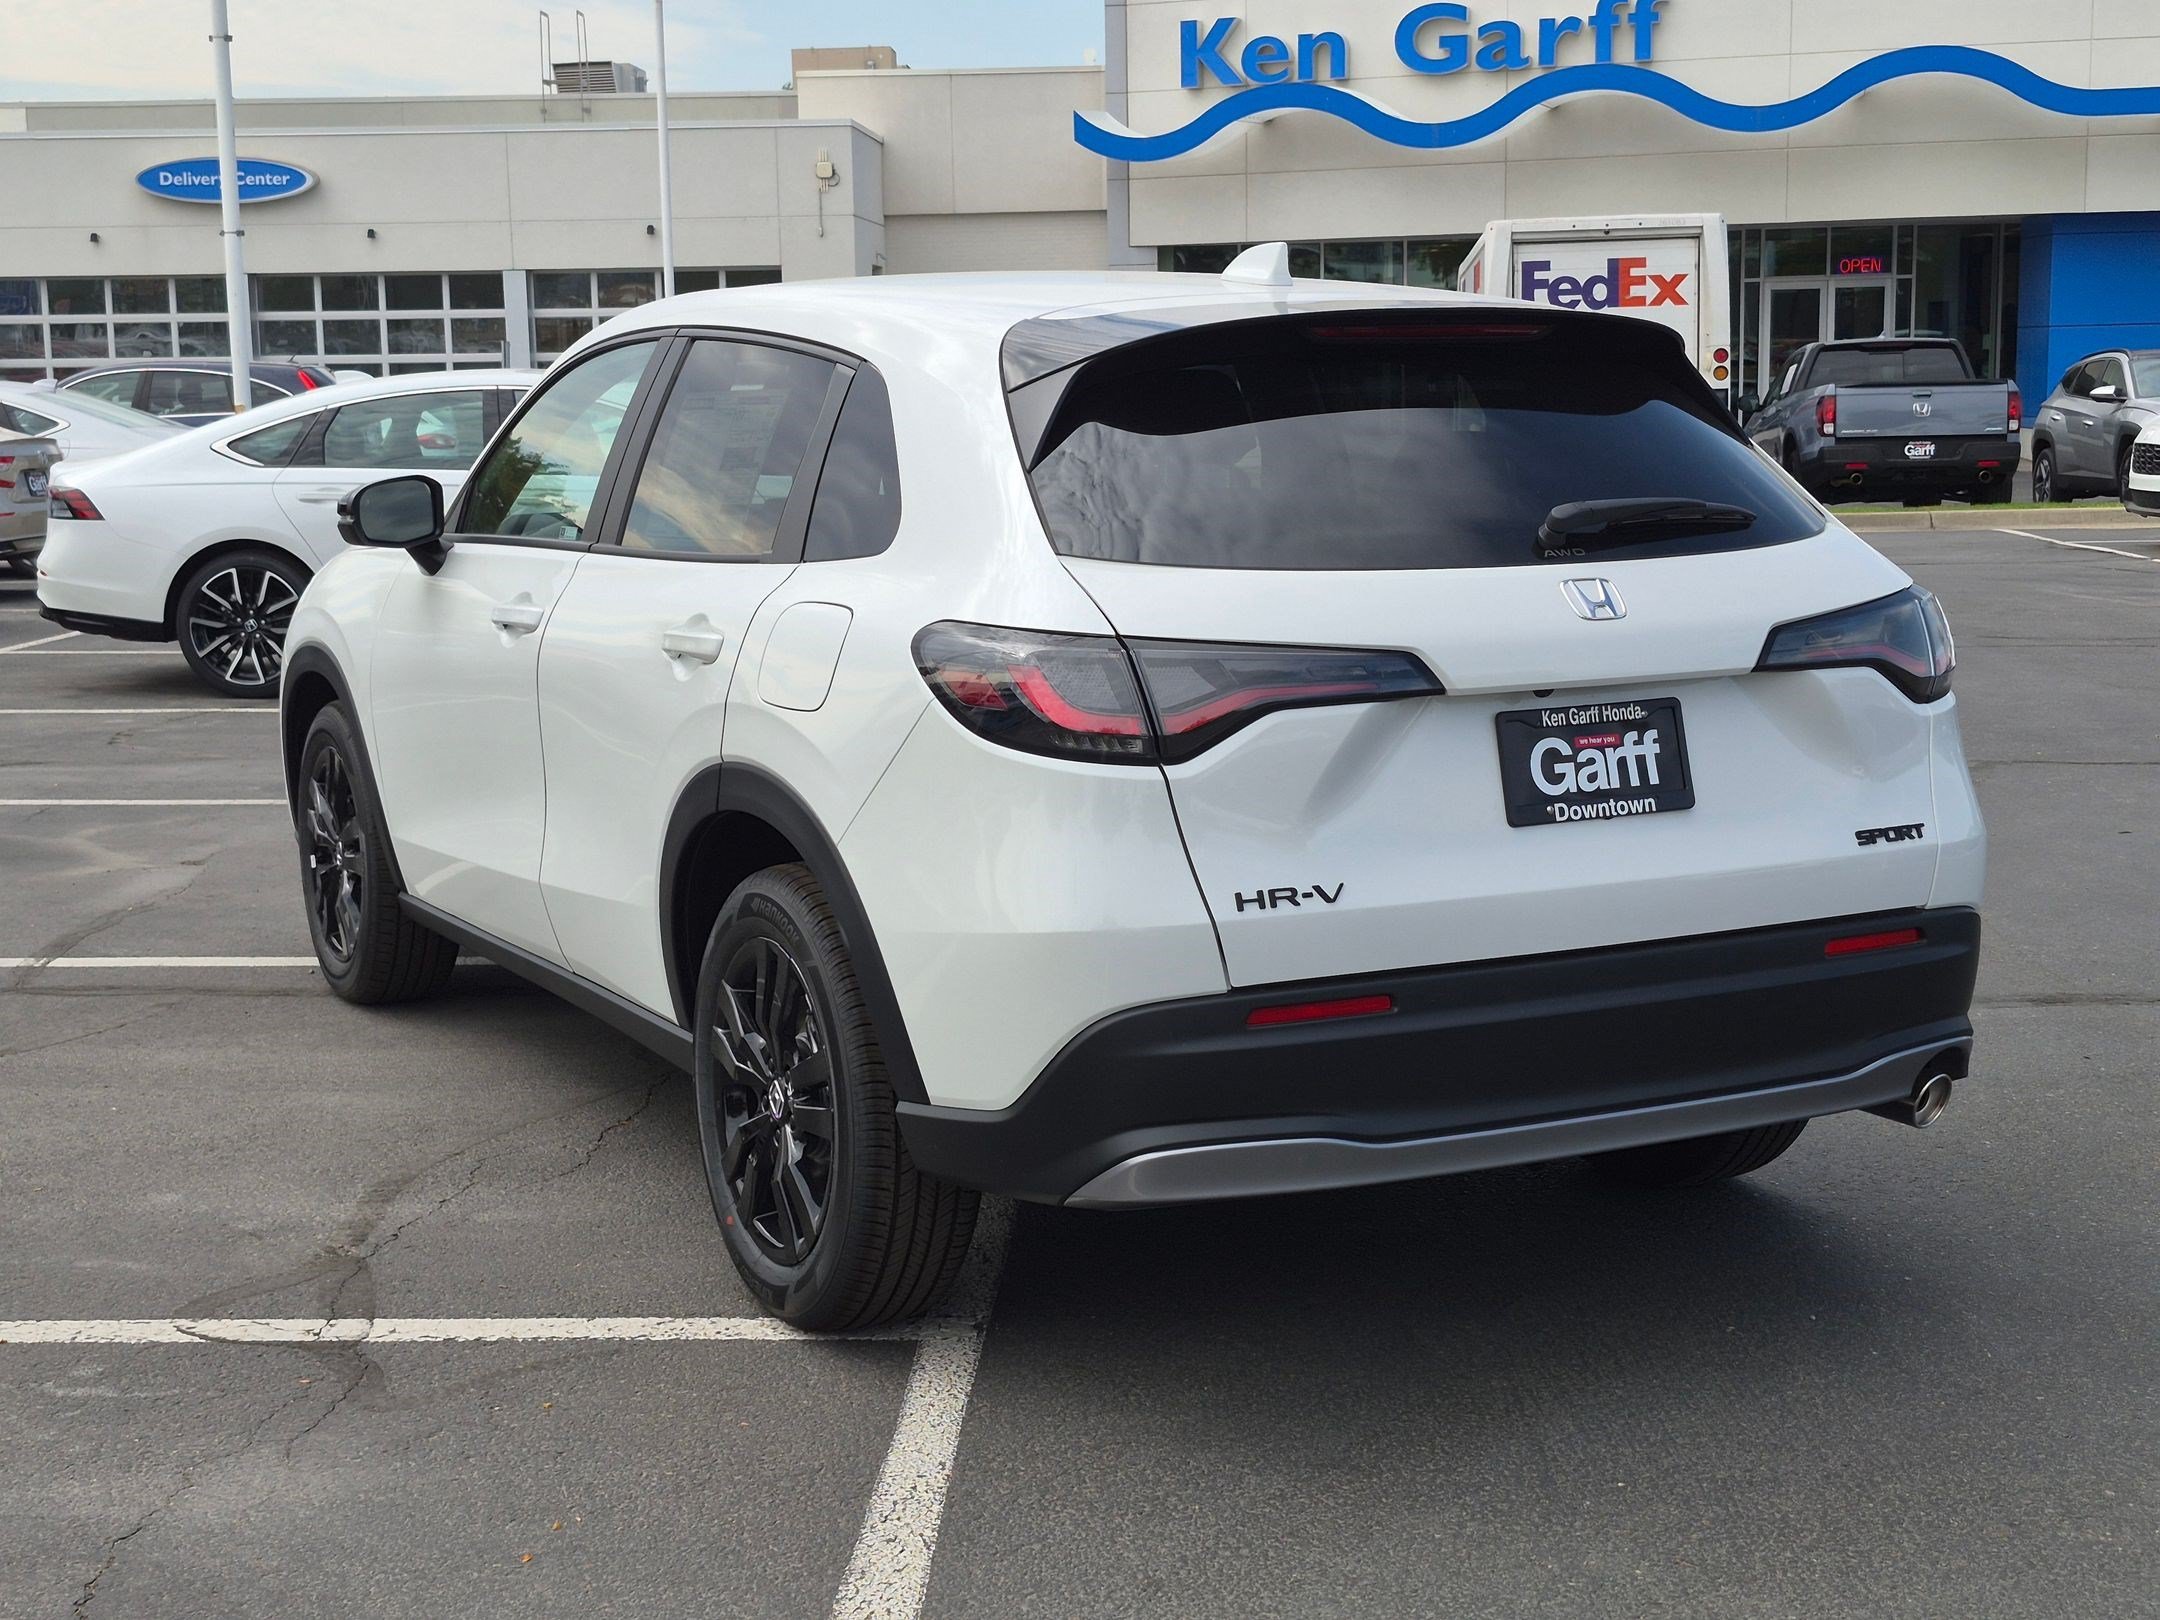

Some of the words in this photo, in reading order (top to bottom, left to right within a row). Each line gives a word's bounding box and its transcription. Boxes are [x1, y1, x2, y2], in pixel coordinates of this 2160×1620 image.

[1180, 16, 1349, 89] Ken
[1394, 0, 1663, 75] Garff
[236, 172, 290, 186] Center
[1840, 258, 1881, 273] OPEN
[1521, 257, 1689, 310] FedEx
[1904, 443, 1936, 456] Garff
[1544, 548, 1586, 557] AWD
[1541, 710, 1566, 727] Ken
[1569, 706, 1599, 725] Garff
[1602, 703, 1642, 722] Honda
[1603, 736, 1616, 744] you
[1530, 729, 1661, 796] Garff
[1554, 797, 1657, 822] Downtown
[1855, 822, 1925, 846] SPORT
[1234, 882, 1345, 912] HR-V
